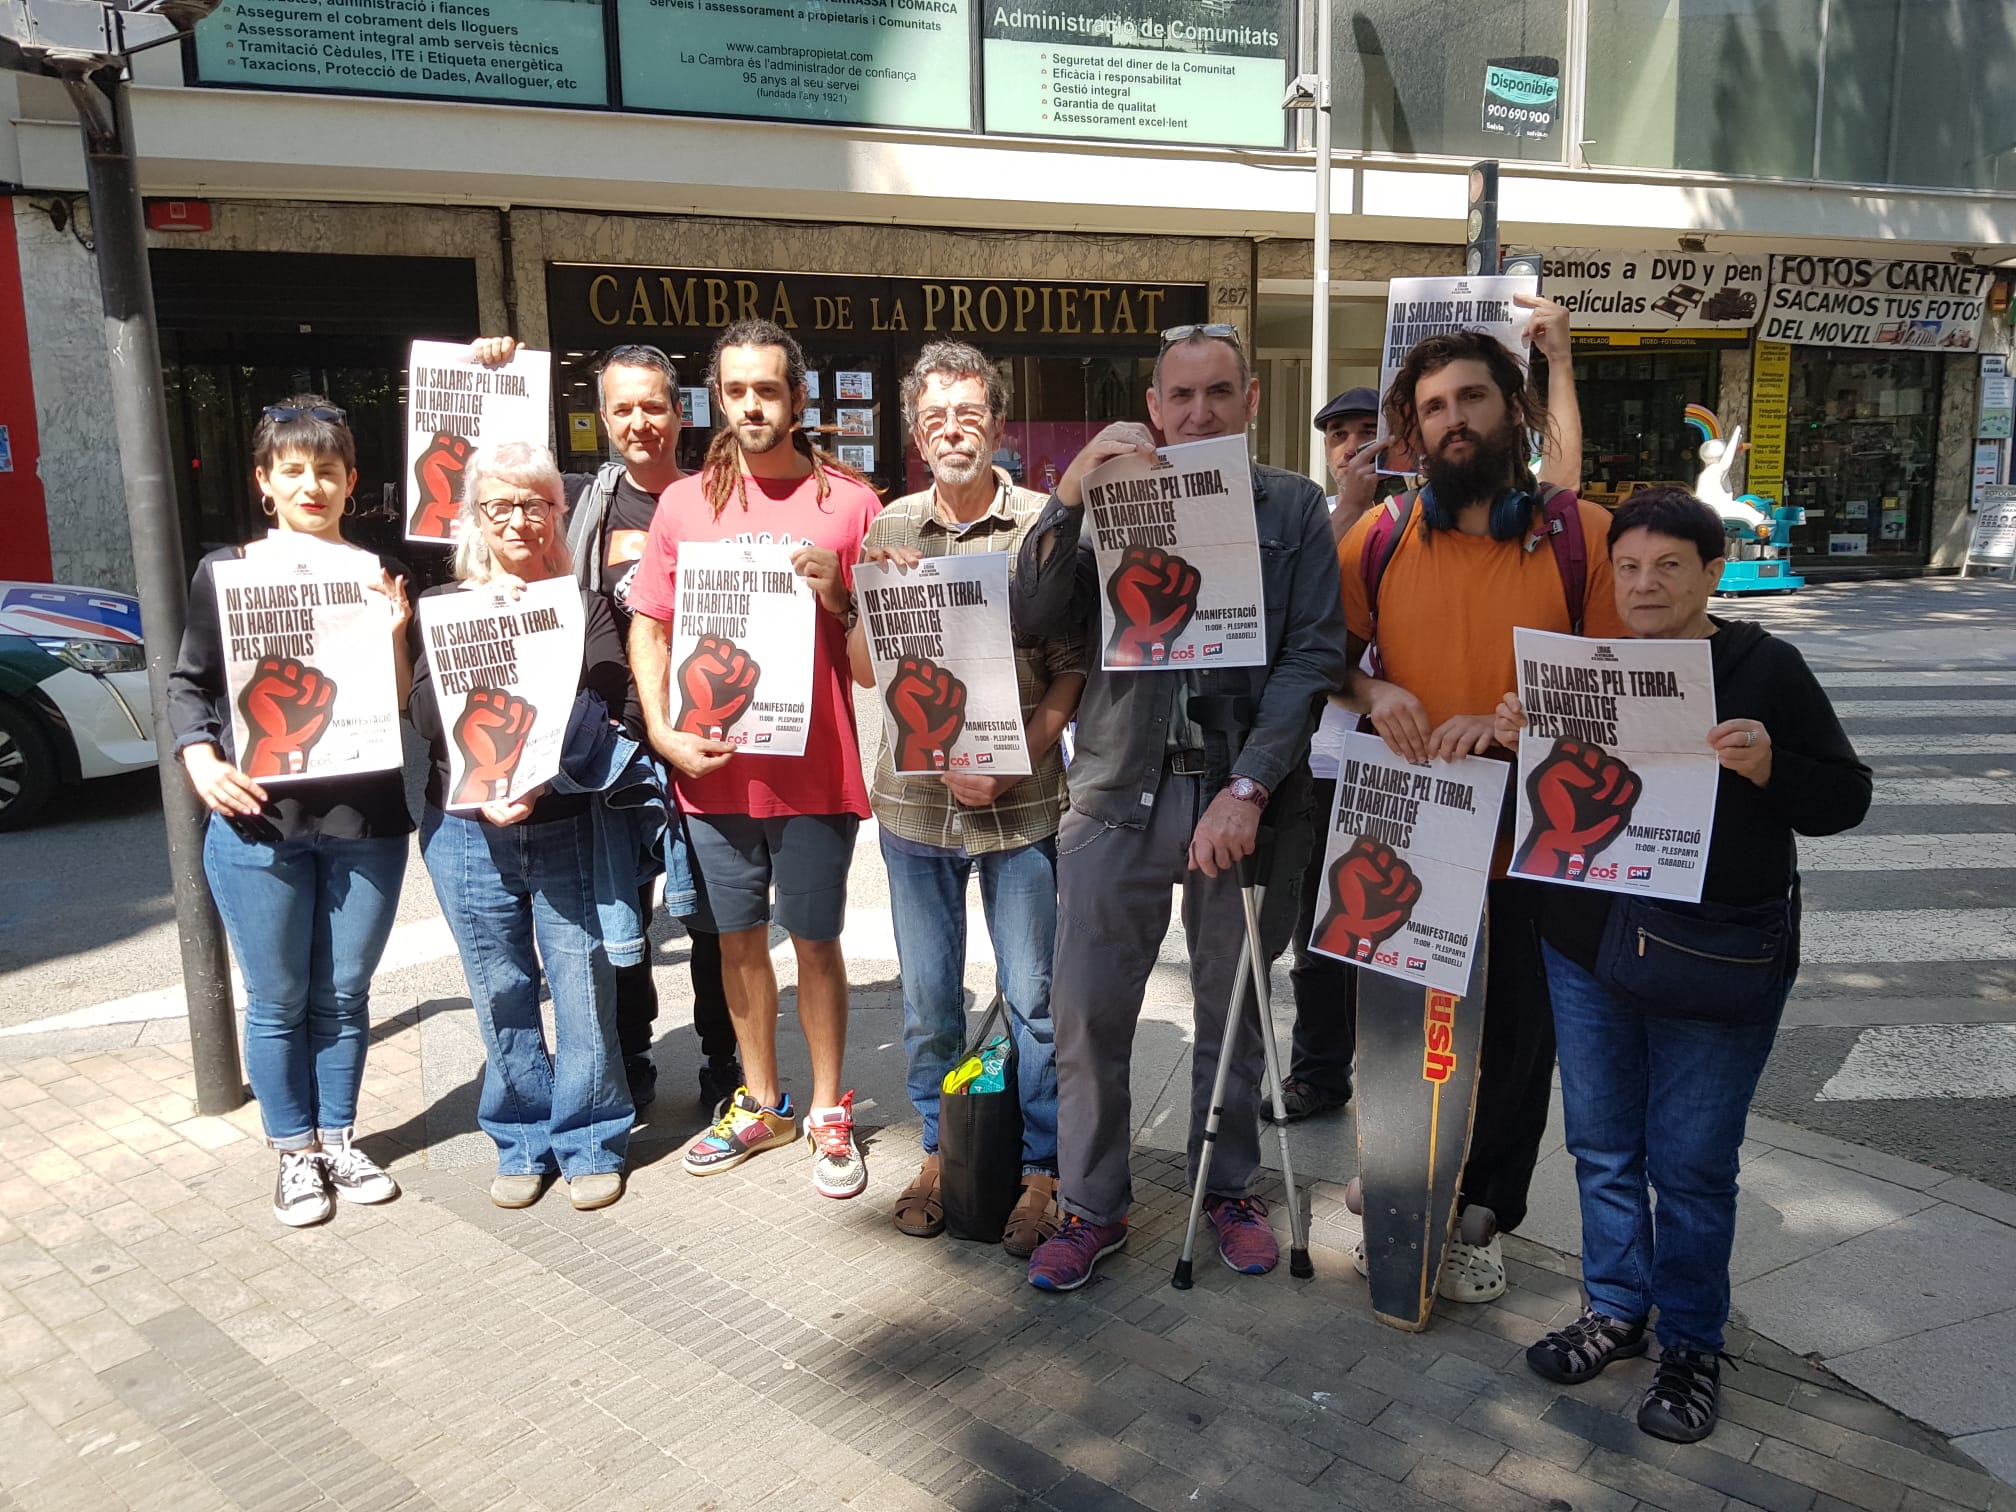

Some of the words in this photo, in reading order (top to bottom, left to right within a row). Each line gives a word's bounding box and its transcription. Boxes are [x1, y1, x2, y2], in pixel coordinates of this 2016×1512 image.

[236, 4, 322, 22] Assegurem
[328, 11, 340, 23] el
[344, 13, 422, 29] cobrament
[427, 18, 456, 32] dels
[462, 20, 518, 36] lloguers
[431, 1, 435, 13] i
[440, 2, 490, 16] fiances
[650, 0, 694, 10] Serveis
[705, 3, 794, 18] assessorament
[798, 11, 805, 19] a
[808, 12, 868, 25] propietaris
[872, 15, 876, 26] i
[878, 16, 942, 31] Comunitats
[898, 0, 958, 14] COMARCA
[237, 22, 355, 41] Assessorament
[360, 30, 414, 46] integral
[419, 36, 449, 48] amb
[454, 38, 504, 52] serveis
[509, 41, 559, 56] tècnics
[994, 6, 1135, 35] Administració
[1142, 18, 1164, 36] de
[1172, 20, 1279, 46] Comunitats
[238, 40, 318, 57] Tramitació
[322, 44, 387, 62] Cèdules,
[392, 50, 415, 62] ITE
[419, 51, 424, 63] i
[428, 52, 486, 68] Etiqueta
[490, 57, 563, 72] energètica
[726, 42, 873, 62] www.cambrapropietat.com
[1052, 53, 1104, 67] Seguretat
[1108, 57, 1122, 68] del
[1126, 59, 1152, 70] diner
[1156, 60, 1168, 71] de
[1172, 61, 1180, 72] la
[1184, 62, 1236, 75] Comunitat
[240, 56, 320, 75] Taxacions,
[326, 62, 396, 78] Protecció
[400, 67, 417, 79] de
[422, 68, 471, 84] Dades,
[474, 72, 552, 89] Avalloguer,
[556, 78, 578, 90] etc
[680, 52, 694, 64] La
[698, 53, 744, 68] Cambra
[748, 57, 761, 69] és
[765, 58, 845, 75] l'administrador
[849, 65, 862, 77] de
[866, 68, 917, 82] confiança
[1053, 68, 1095, 81] Eficàcia
[1098, 71, 1102, 81] i
[1104, 73, 1182, 86] responsabilitat
[743, 72, 757, 84] 95
[760, 74, 786, 87] anys
[790, 75, 800, 86] al
[804, 79, 824, 89] seu
[827, 80, 860, 91] servei
[1053, 82, 1088, 94] Gestió
[1092, 85, 1130, 98] integral
[1491, 72, 1554, 96] Disponible
[756, 88, 797, 100] (fundada
[822, 92, 848, 104] 1921)
[1054, 97, 1098, 110] Garantia
[1102, 100, 1114, 110] de
[1118, 102, 1156, 113] qualitat
[1054, 112, 1136, 126] Assessorament
[1488, 104, 1507, 118] 900
[1508, 108, 1528, 121] 690
[1529, 111, 1550, 124] 900
[1542, 260, 1611, 279] samos
[1622, 263, 1637, 280] a
[1652, 258, 1696, 281] DVD
[1703, 264, 1715, 286] y
[1724, 264, 1762, 286] pen
[1782, 256, 1873, 288] FOTOS
[1886, 261, 1988, 297] CARNET
[588, 274, 798, 329] CAMBRA
[813, 296, 854, 330] DE
[870, 298, 909, 331] LA
[922, 284, 1165, 334] PROPIETAT
[1217, 286, 1248, 305] 267
[1774, 288, 1880, 317] SACAMOS
[1884, 298, 1921, 320] TUS
[1925, 300, 1984, 322] FOTOS
[1393, 302, 1406, 324] NI
[1408, 300, 1455, 324] SALARIS
[1456, 300, 1473, 322] PEL
[1476, 300, 1514, 325] TERRA,
[1766, 317, 1804, 340] DEL
[1809, 321, 1872, 344] MOVIL
[416, 366, 428, 388] NI
[430, 368, 474, 392] SALARIS
[475, 372, 491, 394] PEL
[495, 374, 530, 399] TERRA,
[1088, 486, 1106, 508] NI
[1106, 478, 1160, 505] SALARIS
[1160, 474, 1182, 500] PEL
[1182, 469, 1230, 496] TERRA,
[226, 588, 242, 612] NI
[244, 584, 299, 610] SALARIS
[300, 582, 322, 607] PEL
[323, 581, 368, 606] TERRA,
[683, 568, 696, 590] NI
[697, 569, 740, 592] SALARIS
[742, 571, 758, 593] PEL
[762, 571, 798, 598] TERRA,
[864, 590, 882, 614] NI
[882, 584, 928, 612] SALARIS
[928, 584, 947, 608] PEL
[947, 580, 988, 608] TERRA,
[1195, 604, 1257, 621] MANIFESTACIÓ
[430, 624, 447, 648] NI
[447, 617, 499, 646] SALARIS
[499, 614, 520, 639] PEL
[520, 606, 564, 634] TERRA,
[1524, 660, 1538, 688] NI
[1541, 662, 1600, 695] SALARIS
[1601, 669, 1627, 696] PEL
[1628, 670, 1685, 700] TERRA,
[752, 702, 805, 714] MANIFESTACIÓ
[1524, 687, 1542, 713] NI
[1542, 690, 1619, 722] HABITATGE
[965, 718, 1018, 732] MANIFESTACIÓ
[1528, 713, 1560, 738] PELS
[1344, 760, 1360, 785] NI
[1360, 763, 1411, 796] SALARIS
[1412, 774, 1432, 802] PEL
[1434, 778, 1476, 815] TERRA,
[1626, 824, 1701, 845] MANIFESTACIÓ
[1630, 868, 1650, 878] CNT
[1658, 857, 1695, 870] (SABADELL)
[1406, 920, 1468, 947] MANIFESTACIÓ
[1426, 988, 1457, 1080] ush
